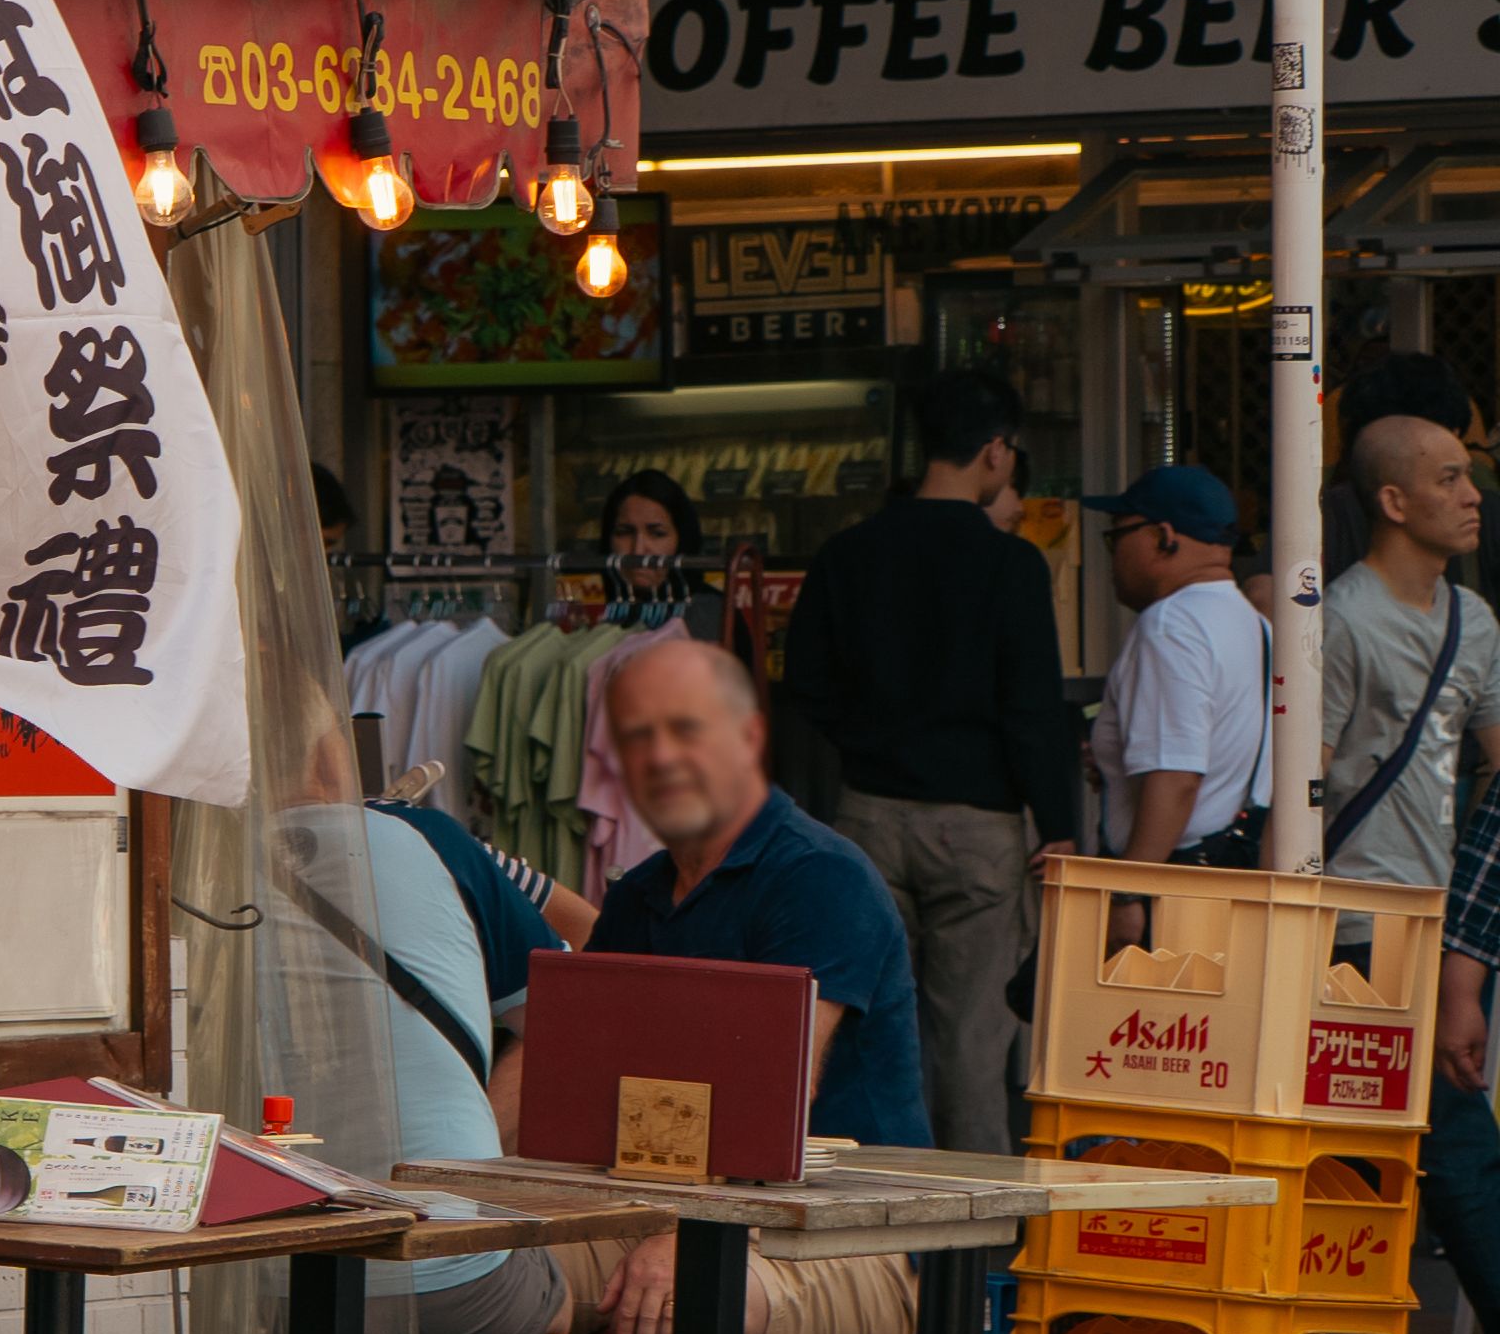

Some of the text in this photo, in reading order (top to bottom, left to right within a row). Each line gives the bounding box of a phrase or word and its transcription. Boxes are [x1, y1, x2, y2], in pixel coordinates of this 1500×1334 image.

[730, 312, 846, 343] BEER
[1108, 1008, 1210, 1054] Asahi
[1084, 1050, 1113, 1080] 大
[1122, 1053, 1191, 1075] ASAHI BEER
[1309, 1027, 1410, 1073] アサヒビール
[1200, 1060, 1229, 1089] 20
[1085, 1213, 1202, 1237] ホッピー
[1298, 1223, 1389, 1278] ホッピー
